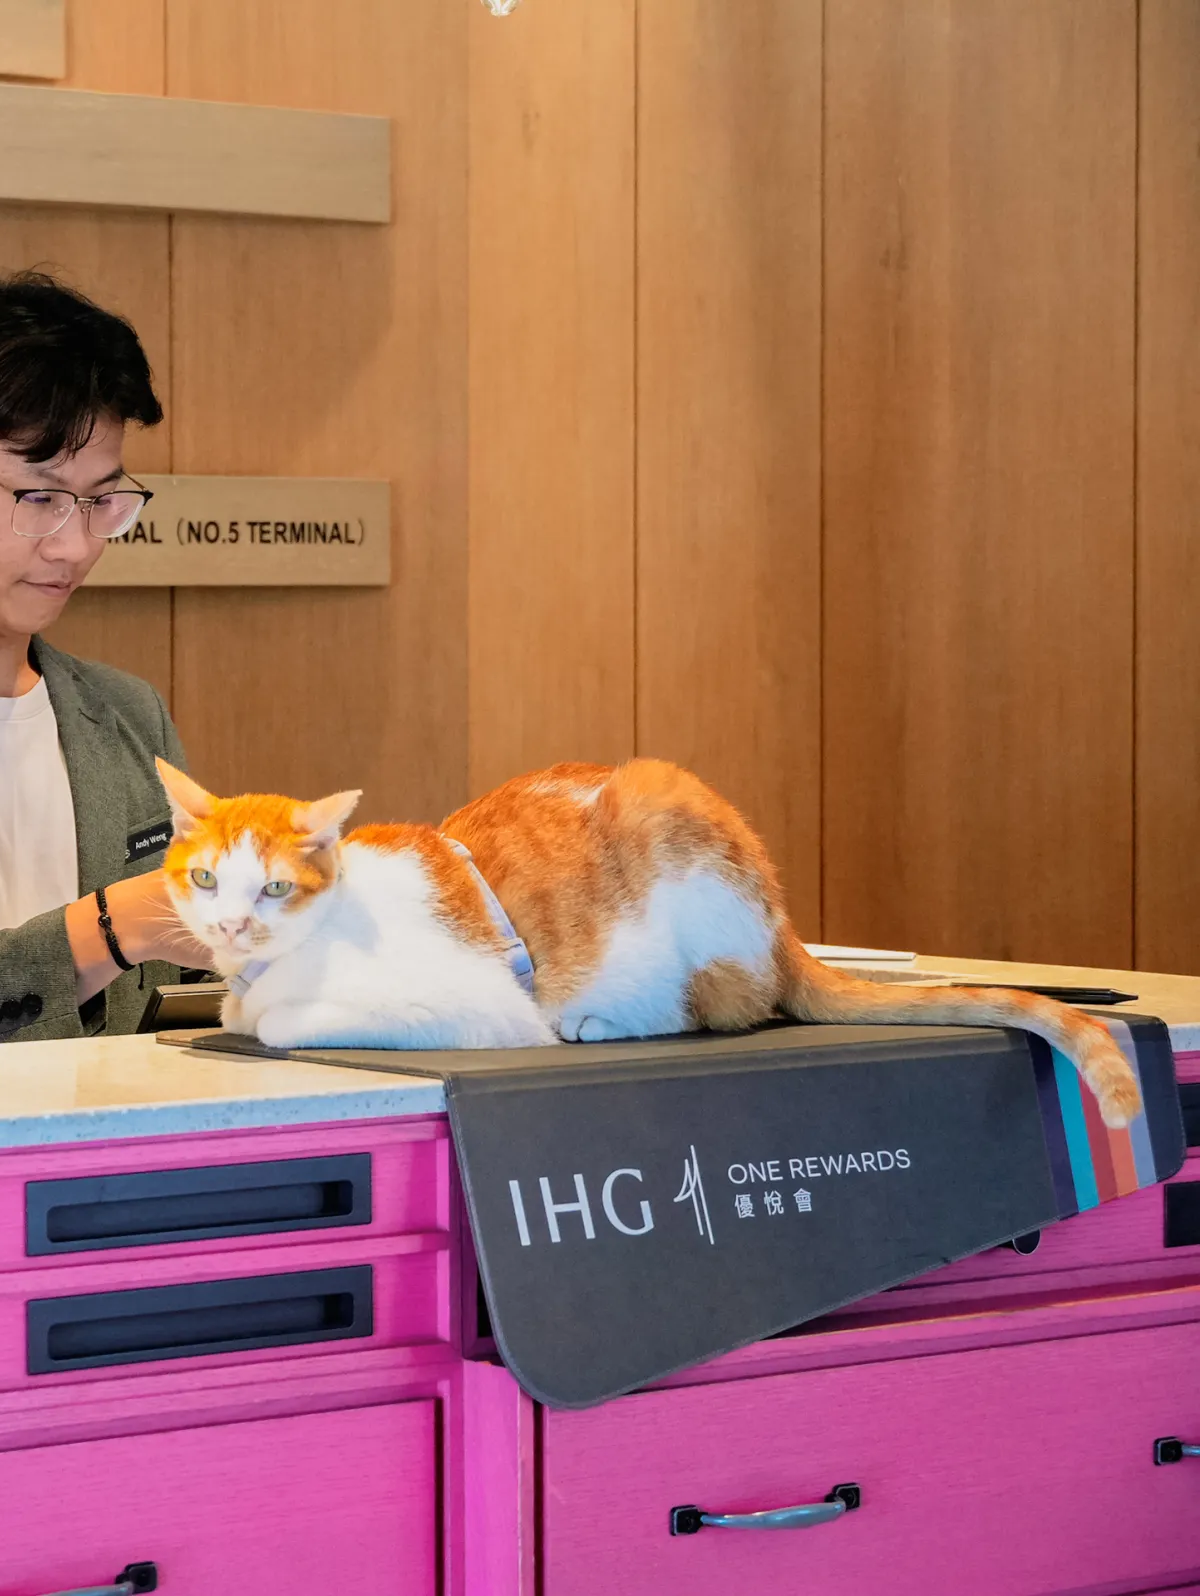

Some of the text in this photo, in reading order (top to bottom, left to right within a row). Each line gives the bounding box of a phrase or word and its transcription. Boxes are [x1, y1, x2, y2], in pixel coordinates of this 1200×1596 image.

[135, 838, 150, 850] Andy
[727, 1148, 912, 1185] ONE REWARDS
[508, 1168, 655, 1247] IHG
